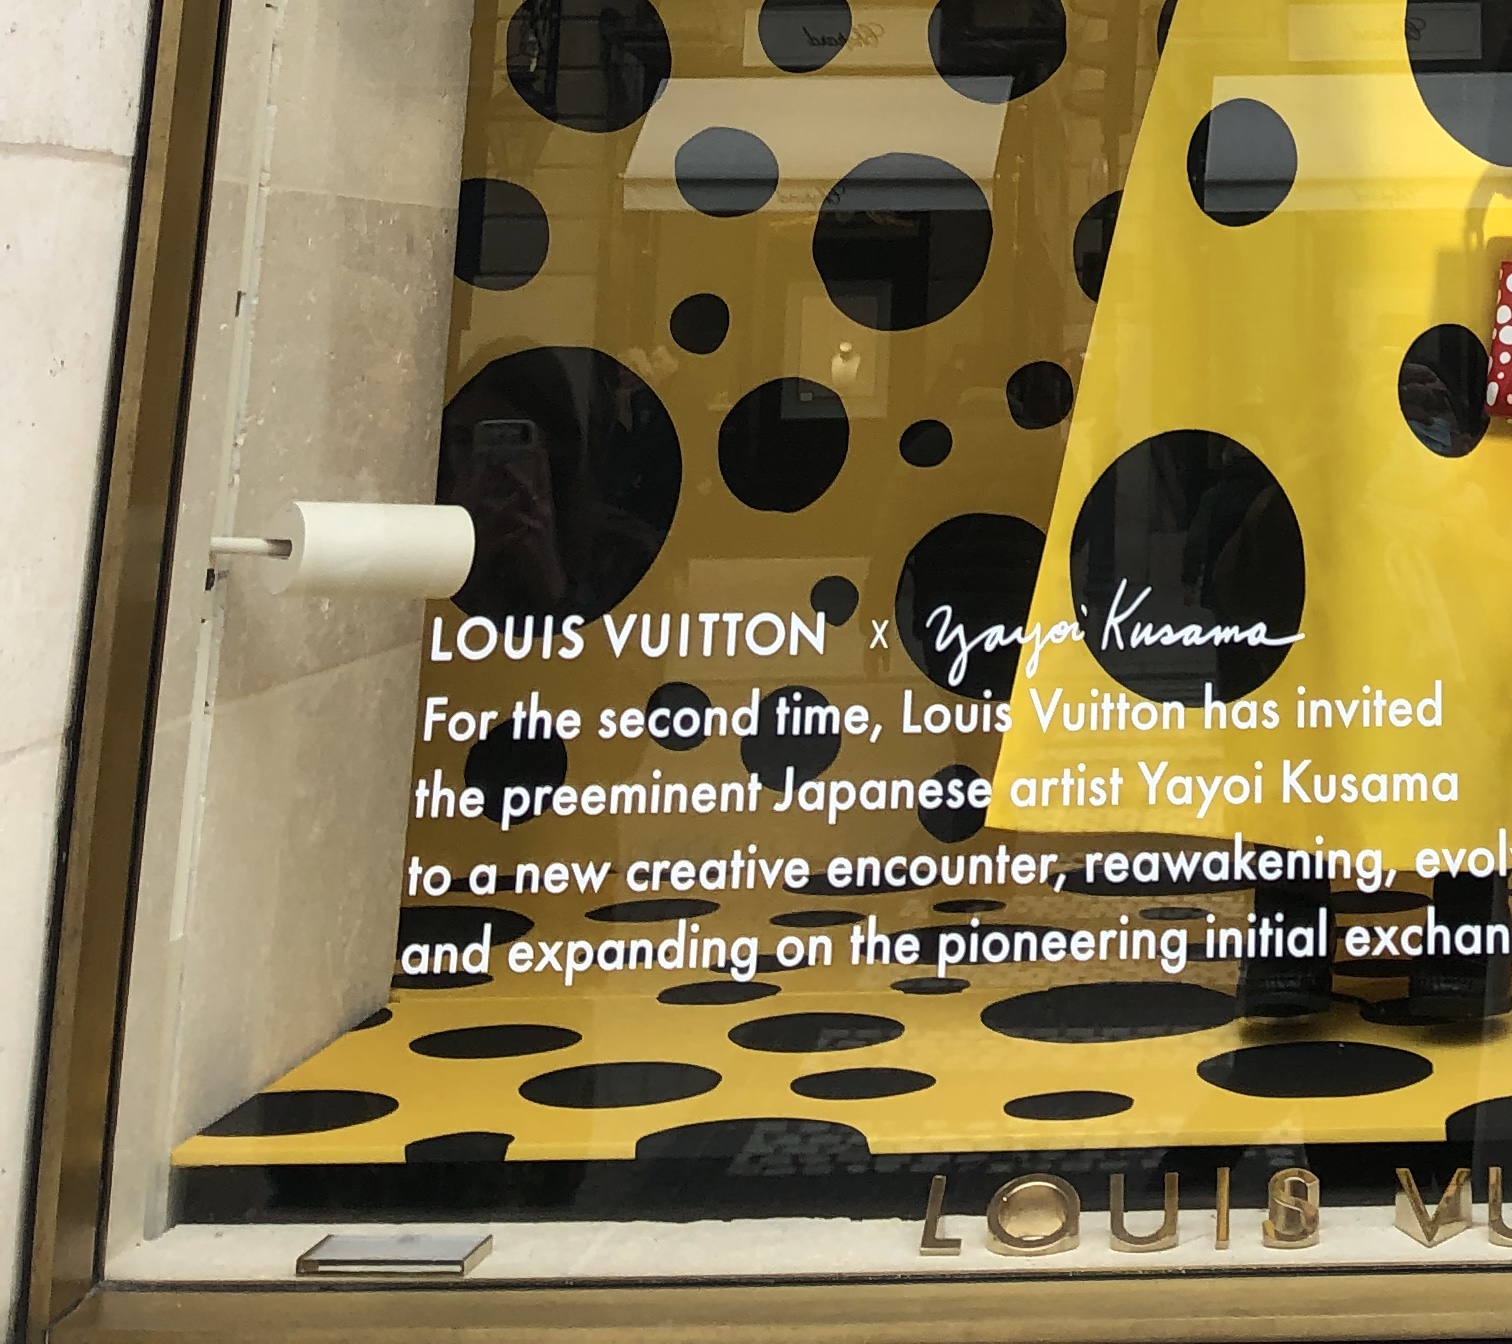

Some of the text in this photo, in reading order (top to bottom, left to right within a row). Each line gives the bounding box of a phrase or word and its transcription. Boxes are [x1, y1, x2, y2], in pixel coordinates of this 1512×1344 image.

[430, 614, 586, 663] LOUIS
[603, 611, 827, 660] VUITTON
[1101, 578, 1306, 651] Kusama
[423, 679, 1443, 743] For the second time, Louis Vuitton has invited
[415, 759, 1459, 831] the preeminent Japanese artist Yayoi Kusama
[408, 856, 452, 897] to
[469, 864, 497, 895] a
[515, 860, 612, 894] new
[626, 843, 811, 892] creative
[827, 844, 1066, 894] encounter,
[1085, 831, 1397, 893] reawakening,
[401, 922, 493, 976] and
[508, 918, 759, 987] expanding
[776, 935, 833, 968] on
[850, 915, 920, 966] the
[936, 914, 1188, 979] pioneering
[1206, 907, 1328, 959] initial
[919, 1166, 1321, 1256] LOUIS
